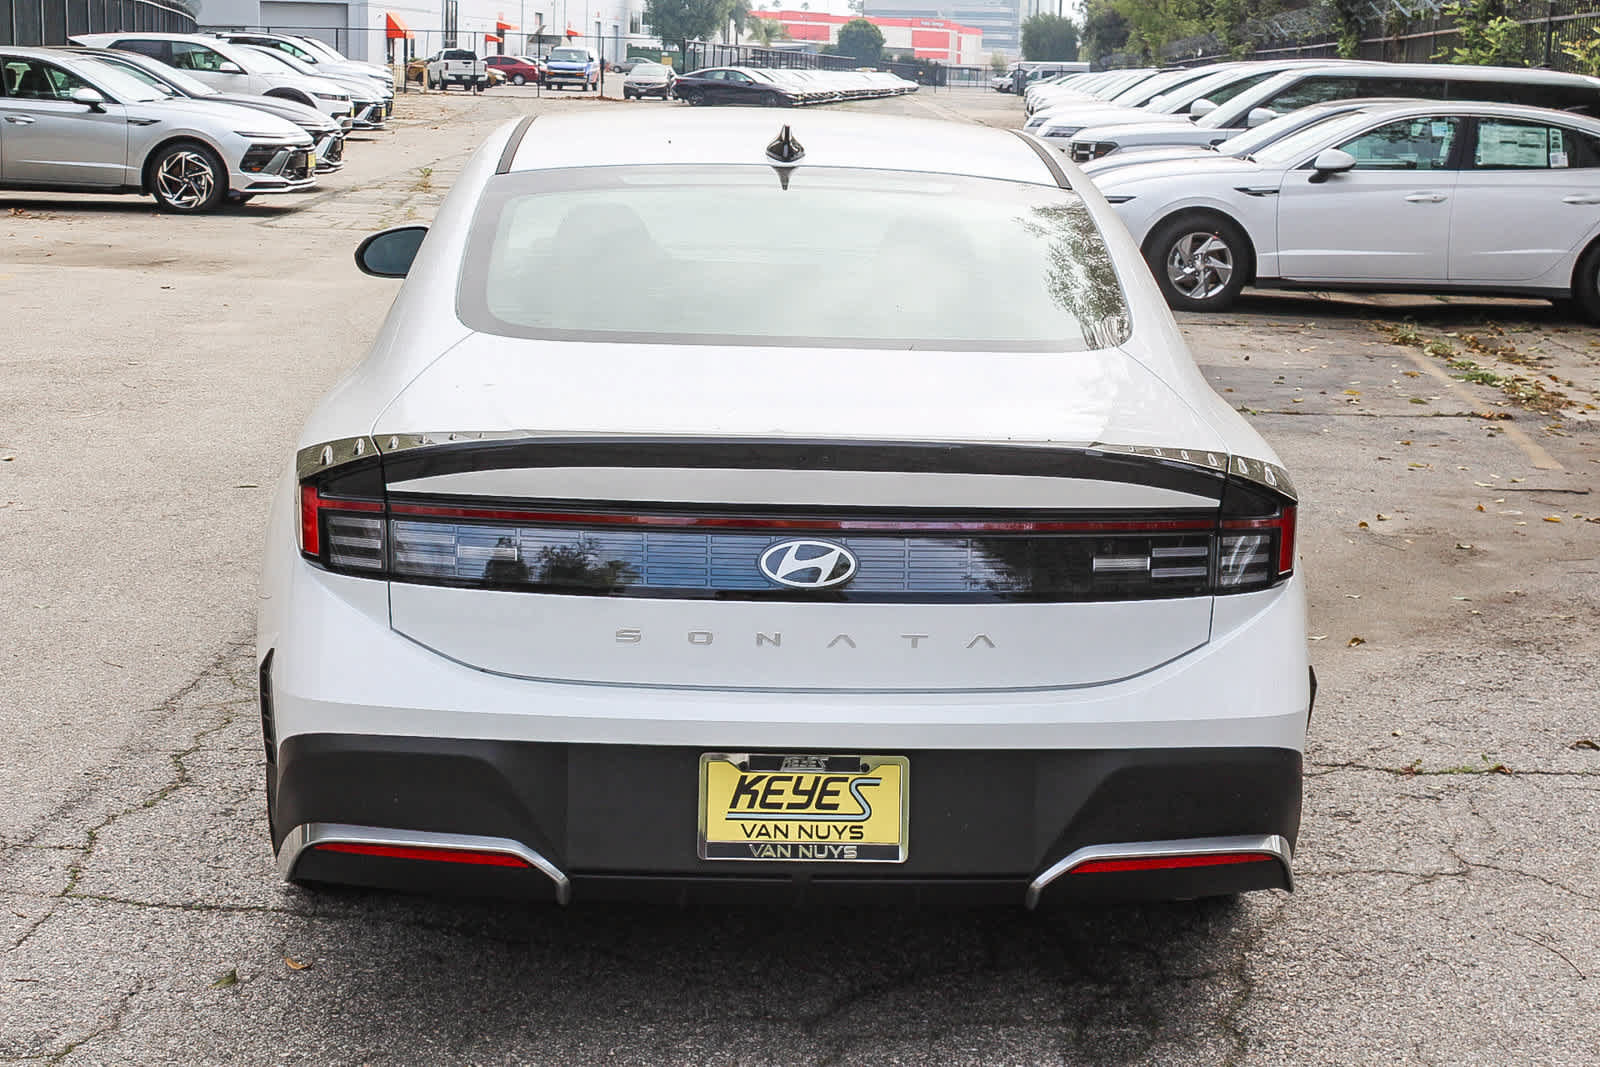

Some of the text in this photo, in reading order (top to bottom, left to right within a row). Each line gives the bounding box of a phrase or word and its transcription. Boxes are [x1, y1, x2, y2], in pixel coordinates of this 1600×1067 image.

[615, 626, 998, 649] SONATA
[727, 774, 882, 822] KEYES
[741, 824, 864, 840] VAN NUYS
[750, 844, 858, 859] VAN NUYS
